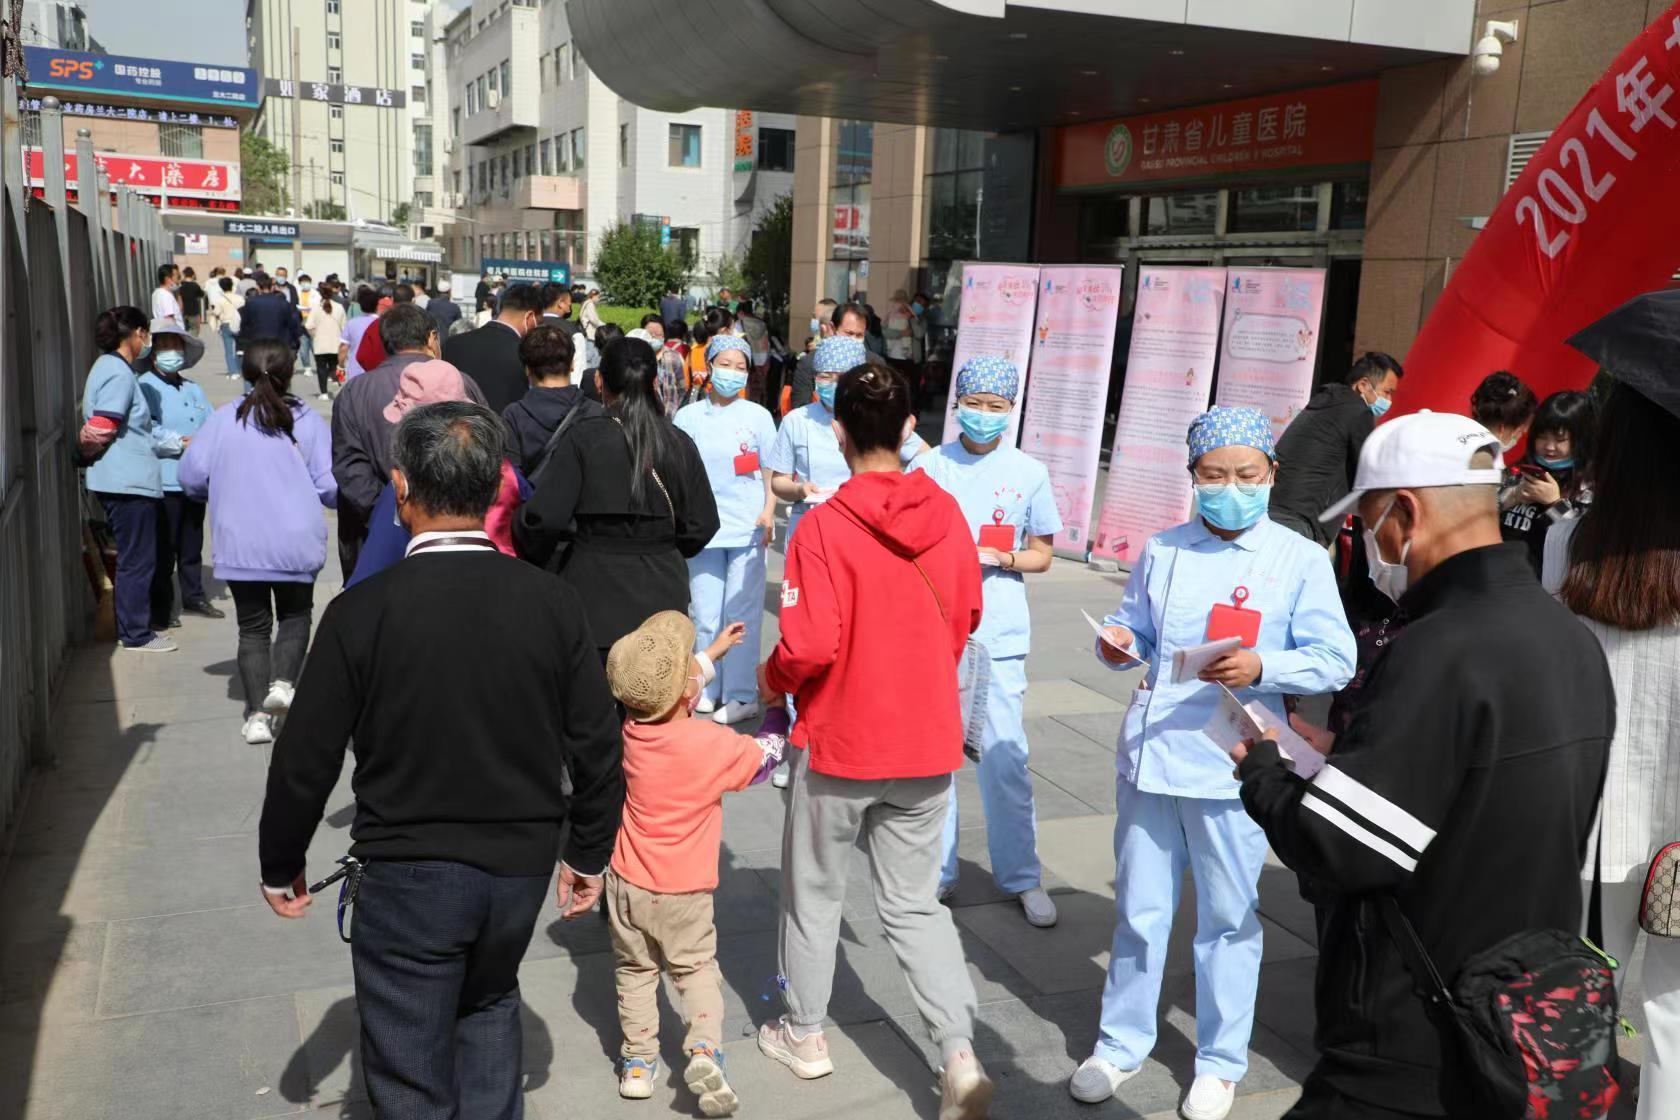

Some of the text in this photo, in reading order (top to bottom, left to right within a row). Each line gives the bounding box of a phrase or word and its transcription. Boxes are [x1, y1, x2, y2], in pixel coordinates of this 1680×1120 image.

[279, 79, 393, 106] 如家酒店
[1142, 101, 1307, 155] 甘肃省儿童医院
[228, 223, 296, 235] 兰大二院人员出口
[1503, 512, 1532, 531] KID
